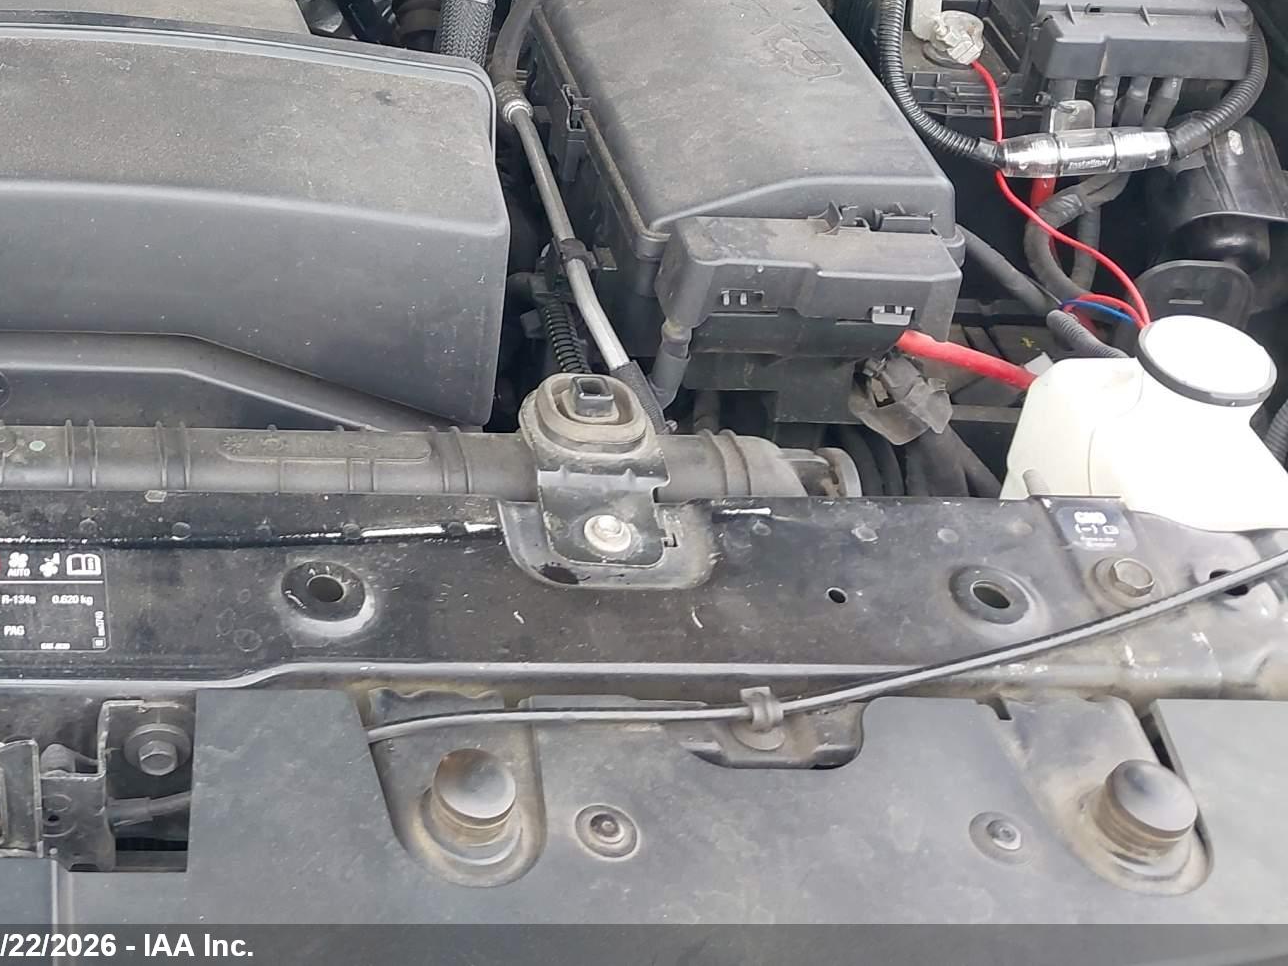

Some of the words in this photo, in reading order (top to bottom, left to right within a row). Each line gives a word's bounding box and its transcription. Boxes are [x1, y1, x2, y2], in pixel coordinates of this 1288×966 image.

[7, 567, 31, 578] AUTO
[1, 594, 37, 605] R-134a
[51, 594, 79, 605] 0.620
[80, 594, 94, 607] kg
[3, 625, 26, 637] PAG
